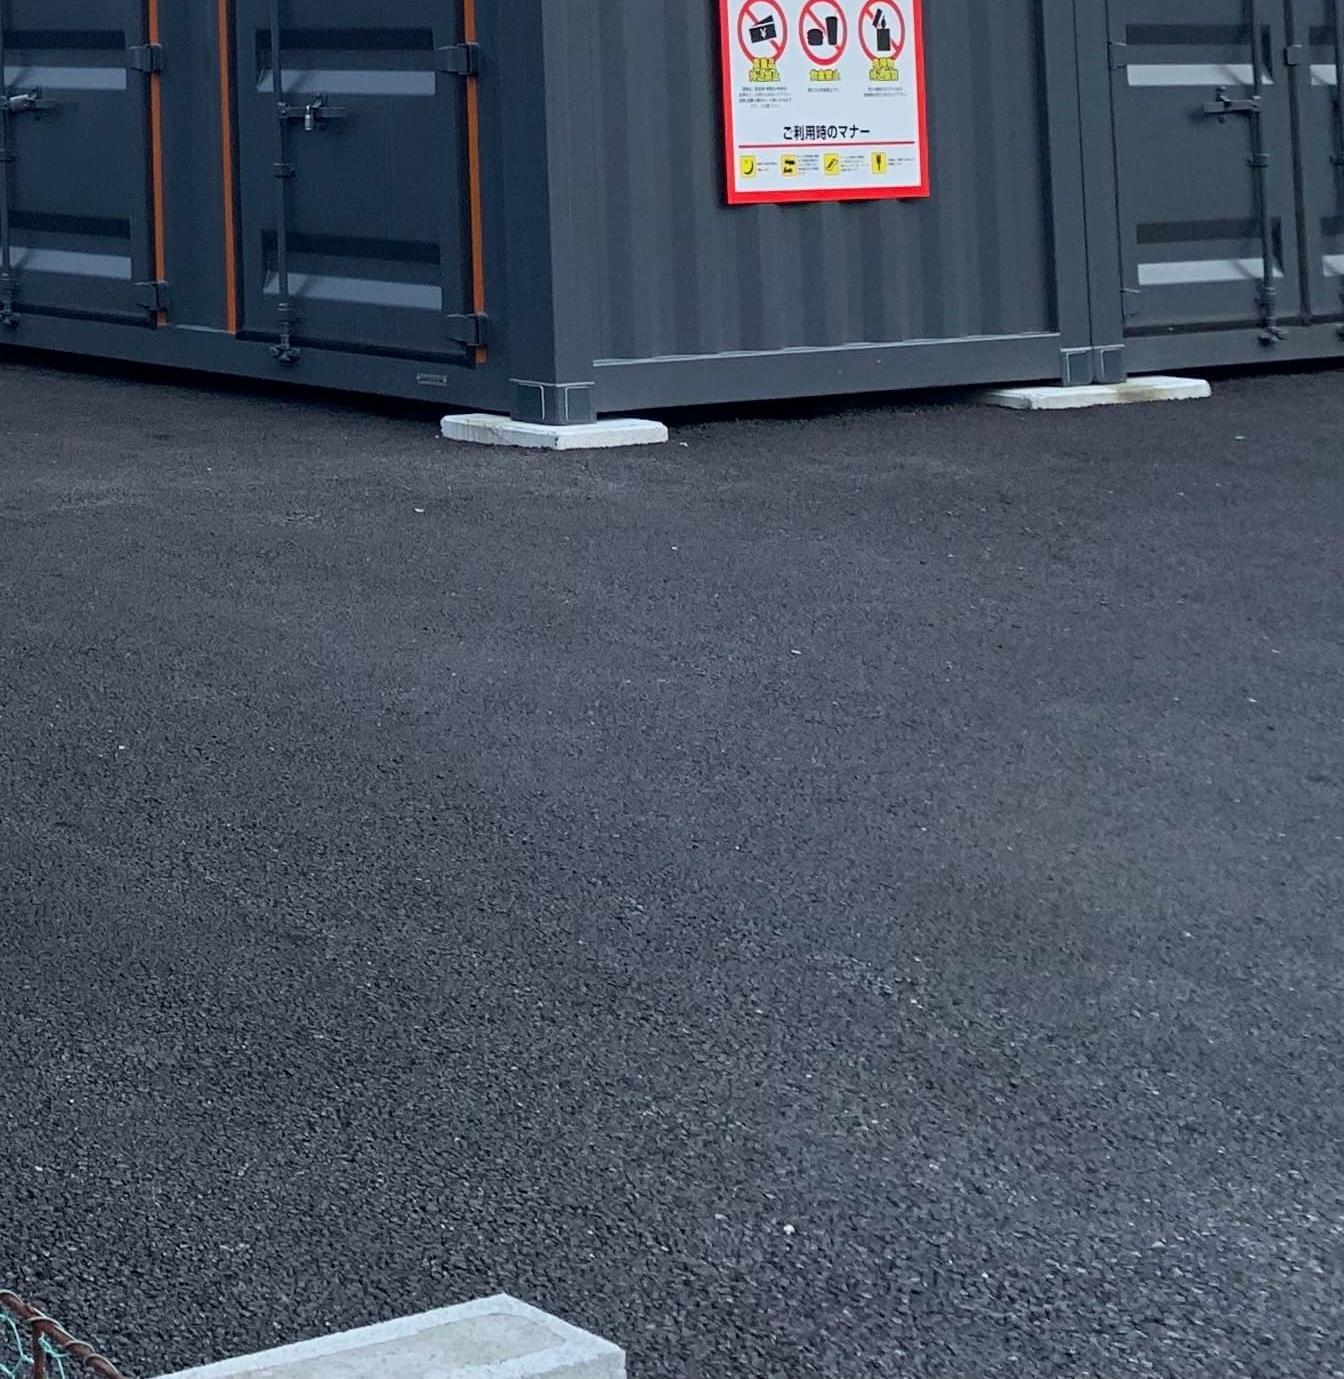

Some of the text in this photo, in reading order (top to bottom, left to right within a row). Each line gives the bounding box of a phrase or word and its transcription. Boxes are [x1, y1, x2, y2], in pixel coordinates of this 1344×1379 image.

[783, 125, 871, 140] ご利用時のマナー
